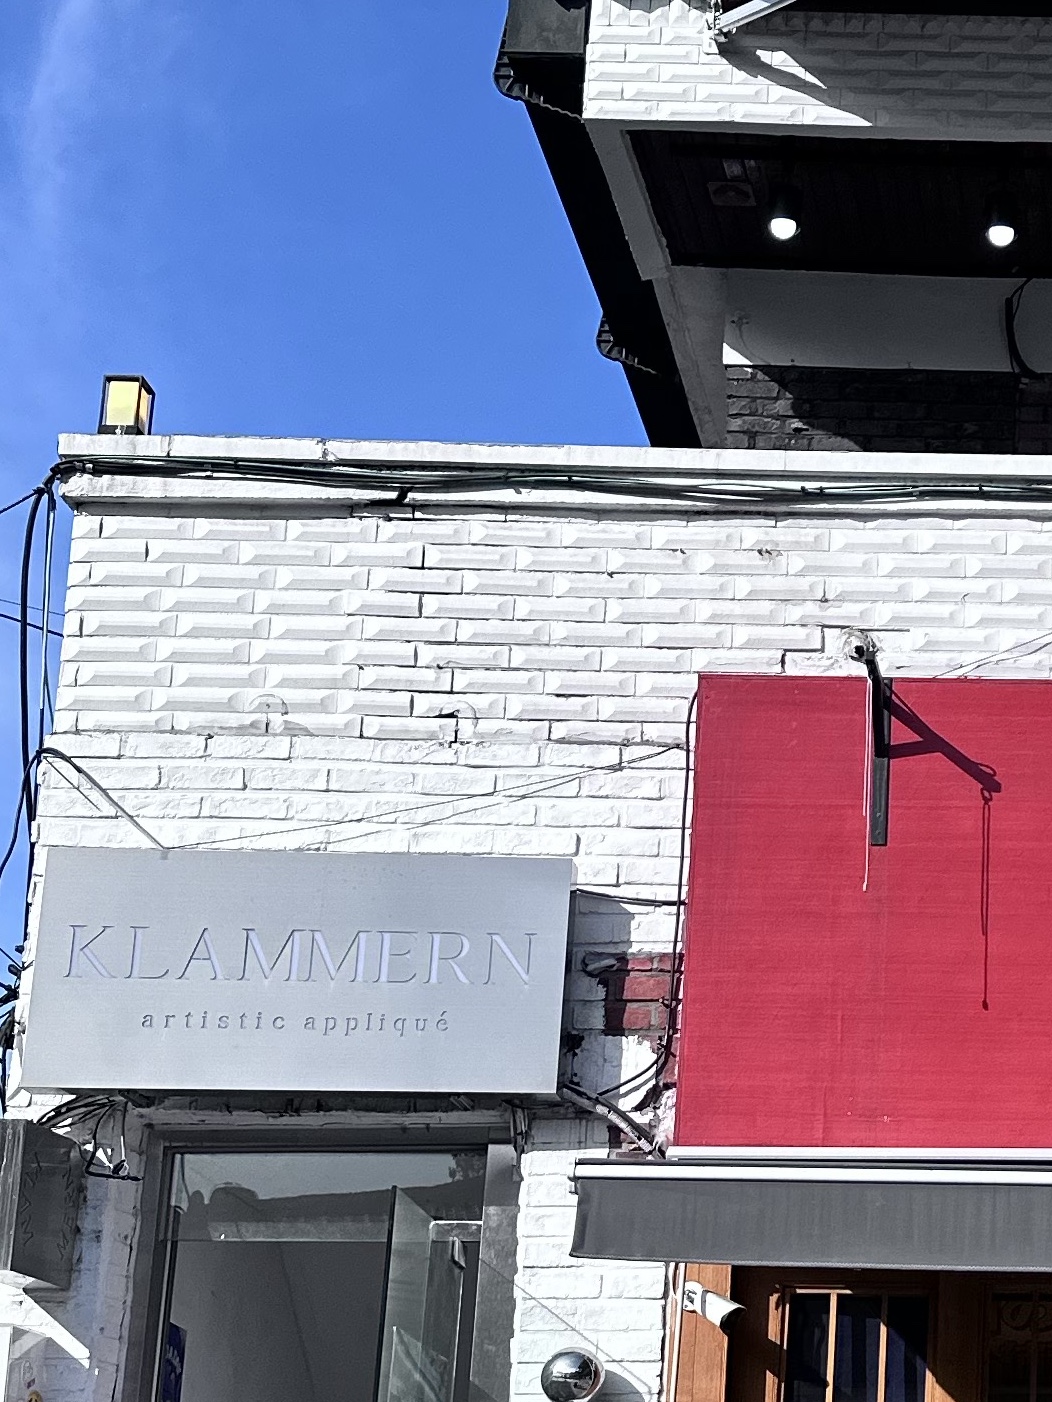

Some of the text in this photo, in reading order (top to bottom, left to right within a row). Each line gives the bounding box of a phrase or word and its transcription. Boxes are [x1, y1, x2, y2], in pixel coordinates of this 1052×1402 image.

[63, 924, 538, 987] KLAMMERN
[141, 1010, 450, 1037] artistic appliqué
